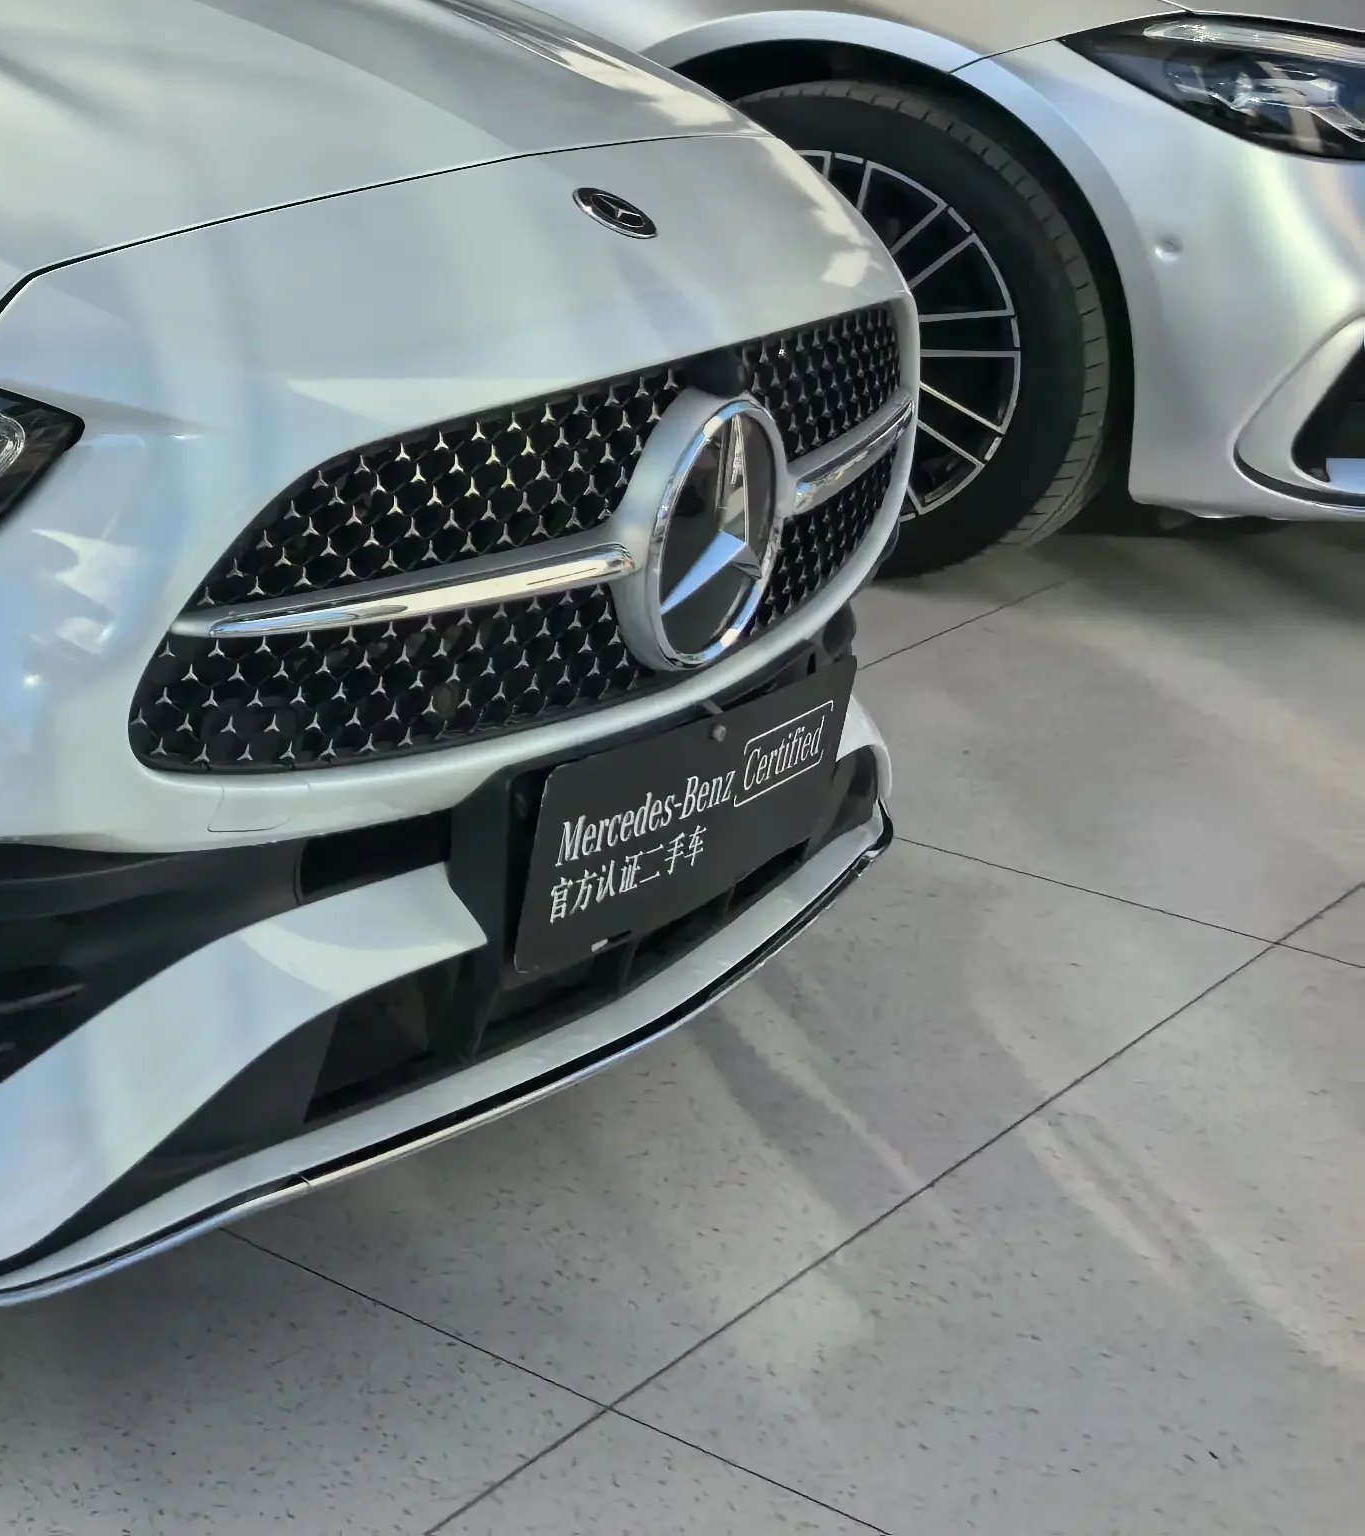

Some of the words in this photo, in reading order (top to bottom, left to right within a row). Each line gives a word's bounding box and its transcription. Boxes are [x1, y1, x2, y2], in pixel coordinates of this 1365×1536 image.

[555, 770, 736, 867] Mercedes-Benz
[743, 715, 825, 791] Certified
[548, 825, 707, 924] 官方认证二手车
